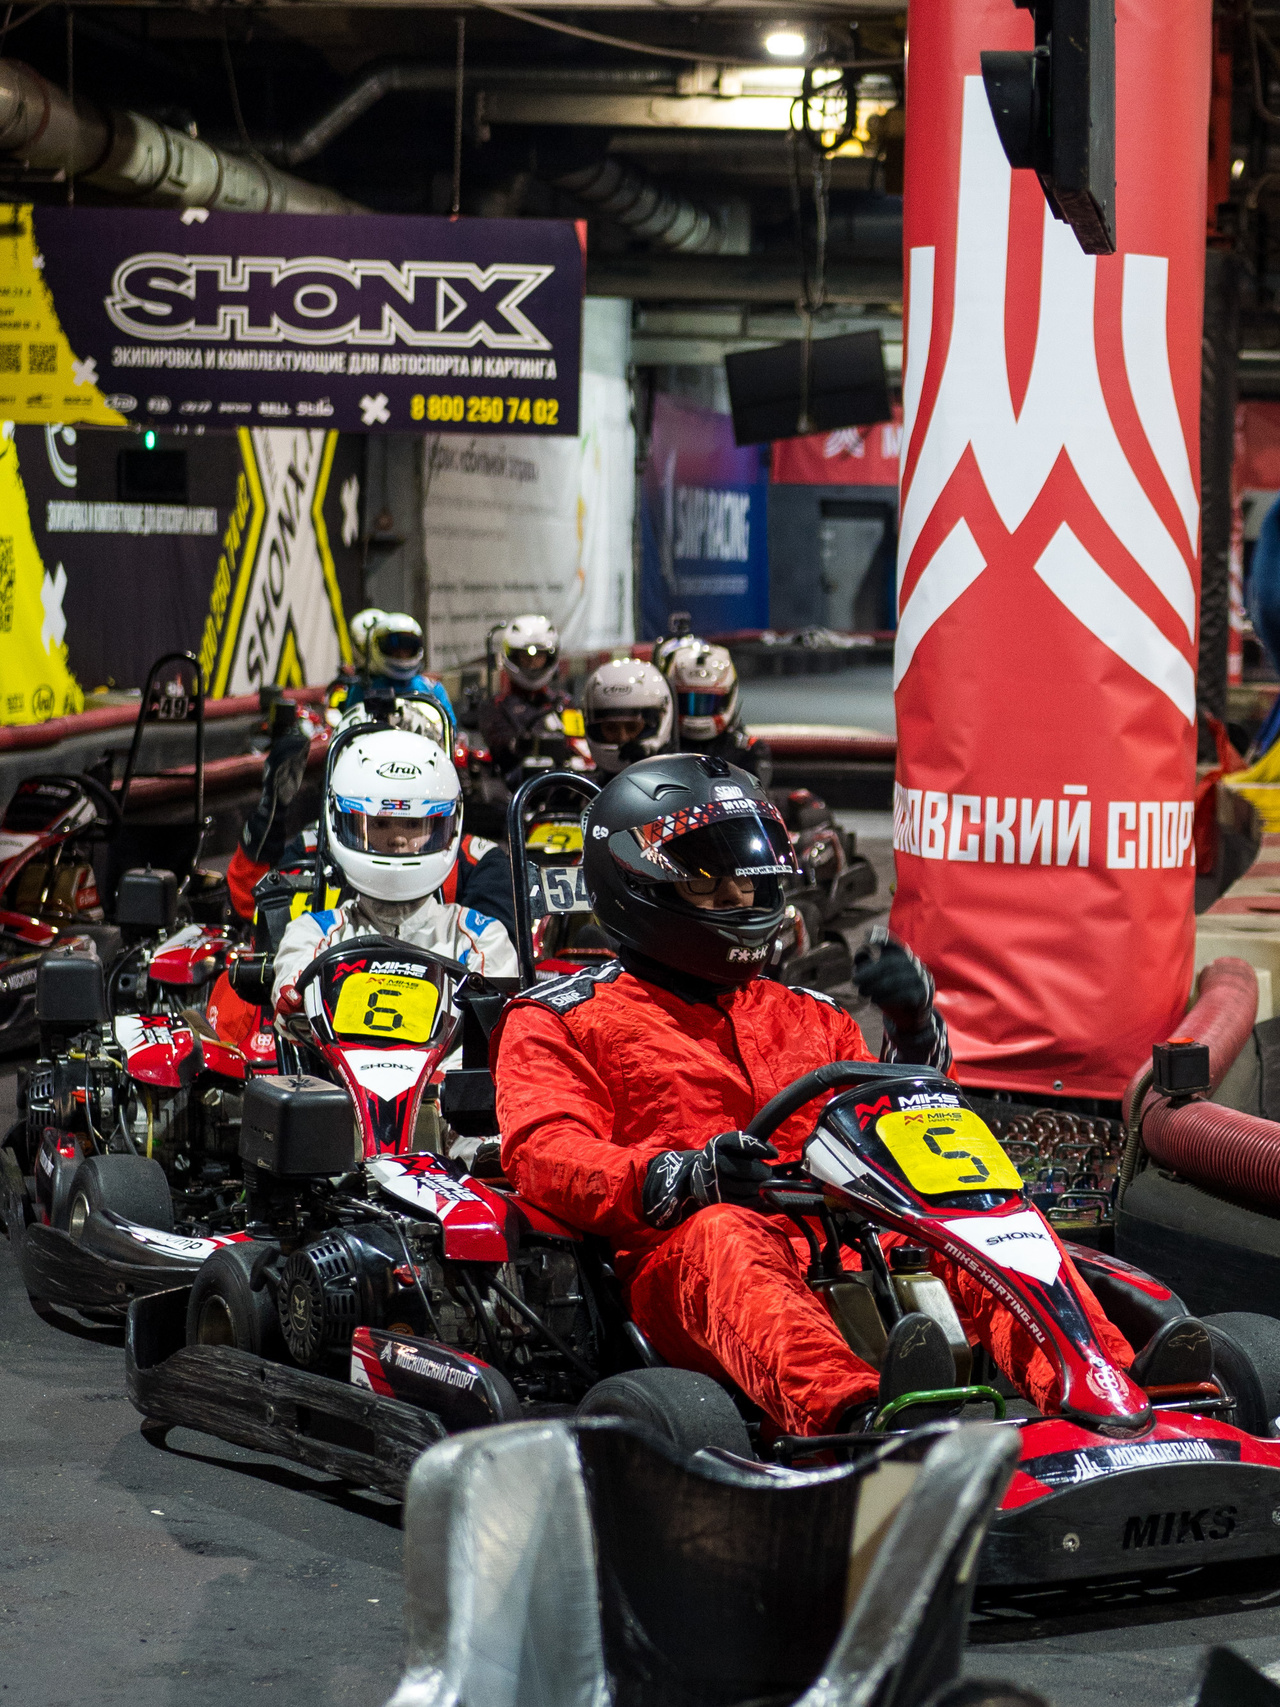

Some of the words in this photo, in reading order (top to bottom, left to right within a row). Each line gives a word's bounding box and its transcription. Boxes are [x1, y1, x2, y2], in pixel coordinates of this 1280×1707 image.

[105, 252, 554, 350] SHONX
[112, 346, 203, 368] ЭКИПИРОВКА
[204, 349, 216, 369] И
[218, 349, 346, 374] КОМПЛЕКТУЮЩИЕ
[348, 352, 379, 375] ДЛЯ
[380, 353, 470, 376] АВТОСПОРТА
[471, 356, 483, 377] И
[484, 357, 557, 380] КАРТИНГА
[410, 394, 425, 421] 8
[426, 394, 465, 422] 800
[466, 396, 504, 423] 250
[506, 397, 531, 424] 74
[532, 398, 559, 425] 02
[385, 762, 417, 775] Arai
[714, 786, 743, 799] SEND
[371, 961, 428, 974] MIKS
[388, 979, 419, 988] MIKS
[363, 989, 403, 1032] 6
[360, 1063, 416, 1072] SHONX
[898, 1093, 960, 1107] MIKS
[923, 1126, 990, 1184] 5
[986, 1230, 1049, 1246] SHONX
[944, 1241, 1046, 1345] MIKS-KARTING.RU
[395, 1353, 450, 1382] МОСКОВСКИЙ
[448, 1367, 479, 1391] СПОРТ
[1106, 1438, 1216, 1466] МОСКОВСКИЙ
[1122, 1505, 1238, 1550] MIKS
